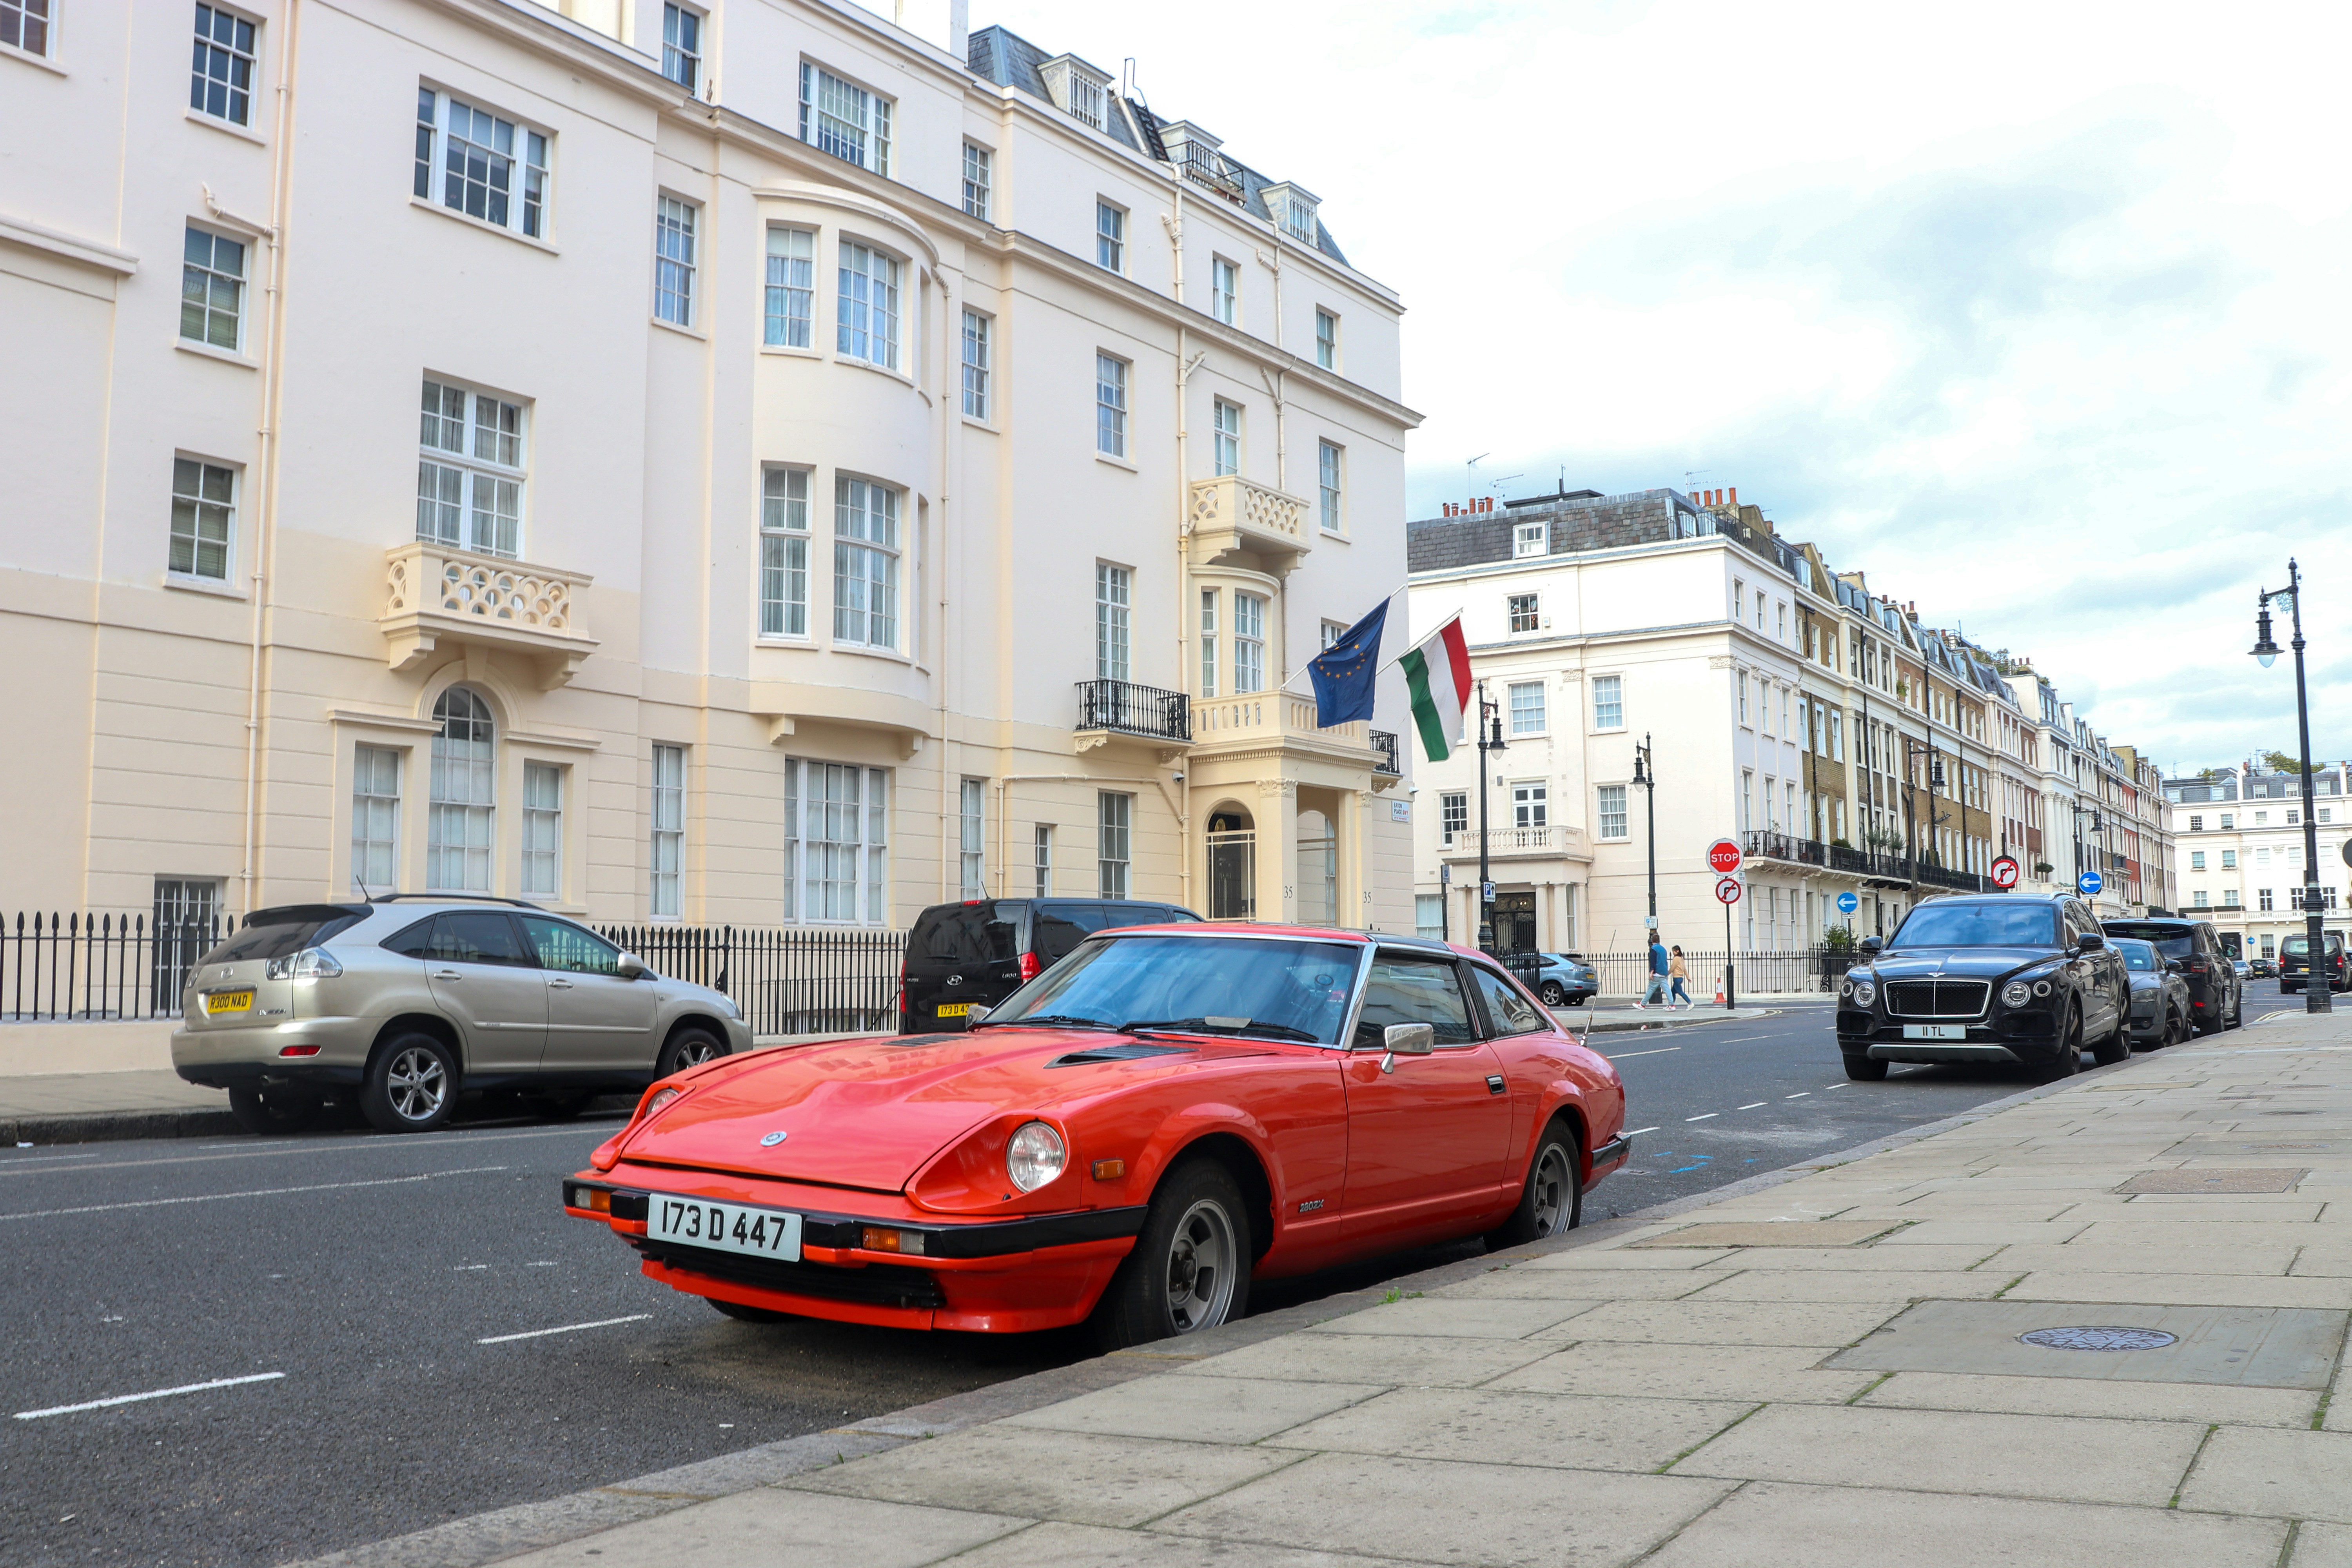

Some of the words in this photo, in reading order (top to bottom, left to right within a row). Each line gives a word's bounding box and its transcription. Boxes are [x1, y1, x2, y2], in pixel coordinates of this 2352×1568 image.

[1711, 853, 1738, 862] STOP
[1284, 886, 1293, 898] 35
[1486, 885, 1490, 894] P
[1363, 891, 1371, 904] 35
[210, 995, 230, 1010] R300
[231, 994, 248, 1007] NAD
[941, 1006, 952, 1015] 173
[954, 1006, 958, 1014] D
[960, 1005, 970, 1014] 43
[1931, 1027, 1945, 1036] TL
[1299, 1199, 1324, 1213] 280ZX
[662, 1201, 701, 1237] 173
[708, 1207, 724, 1241] D
[732, 1212, 786, 1251] 447
